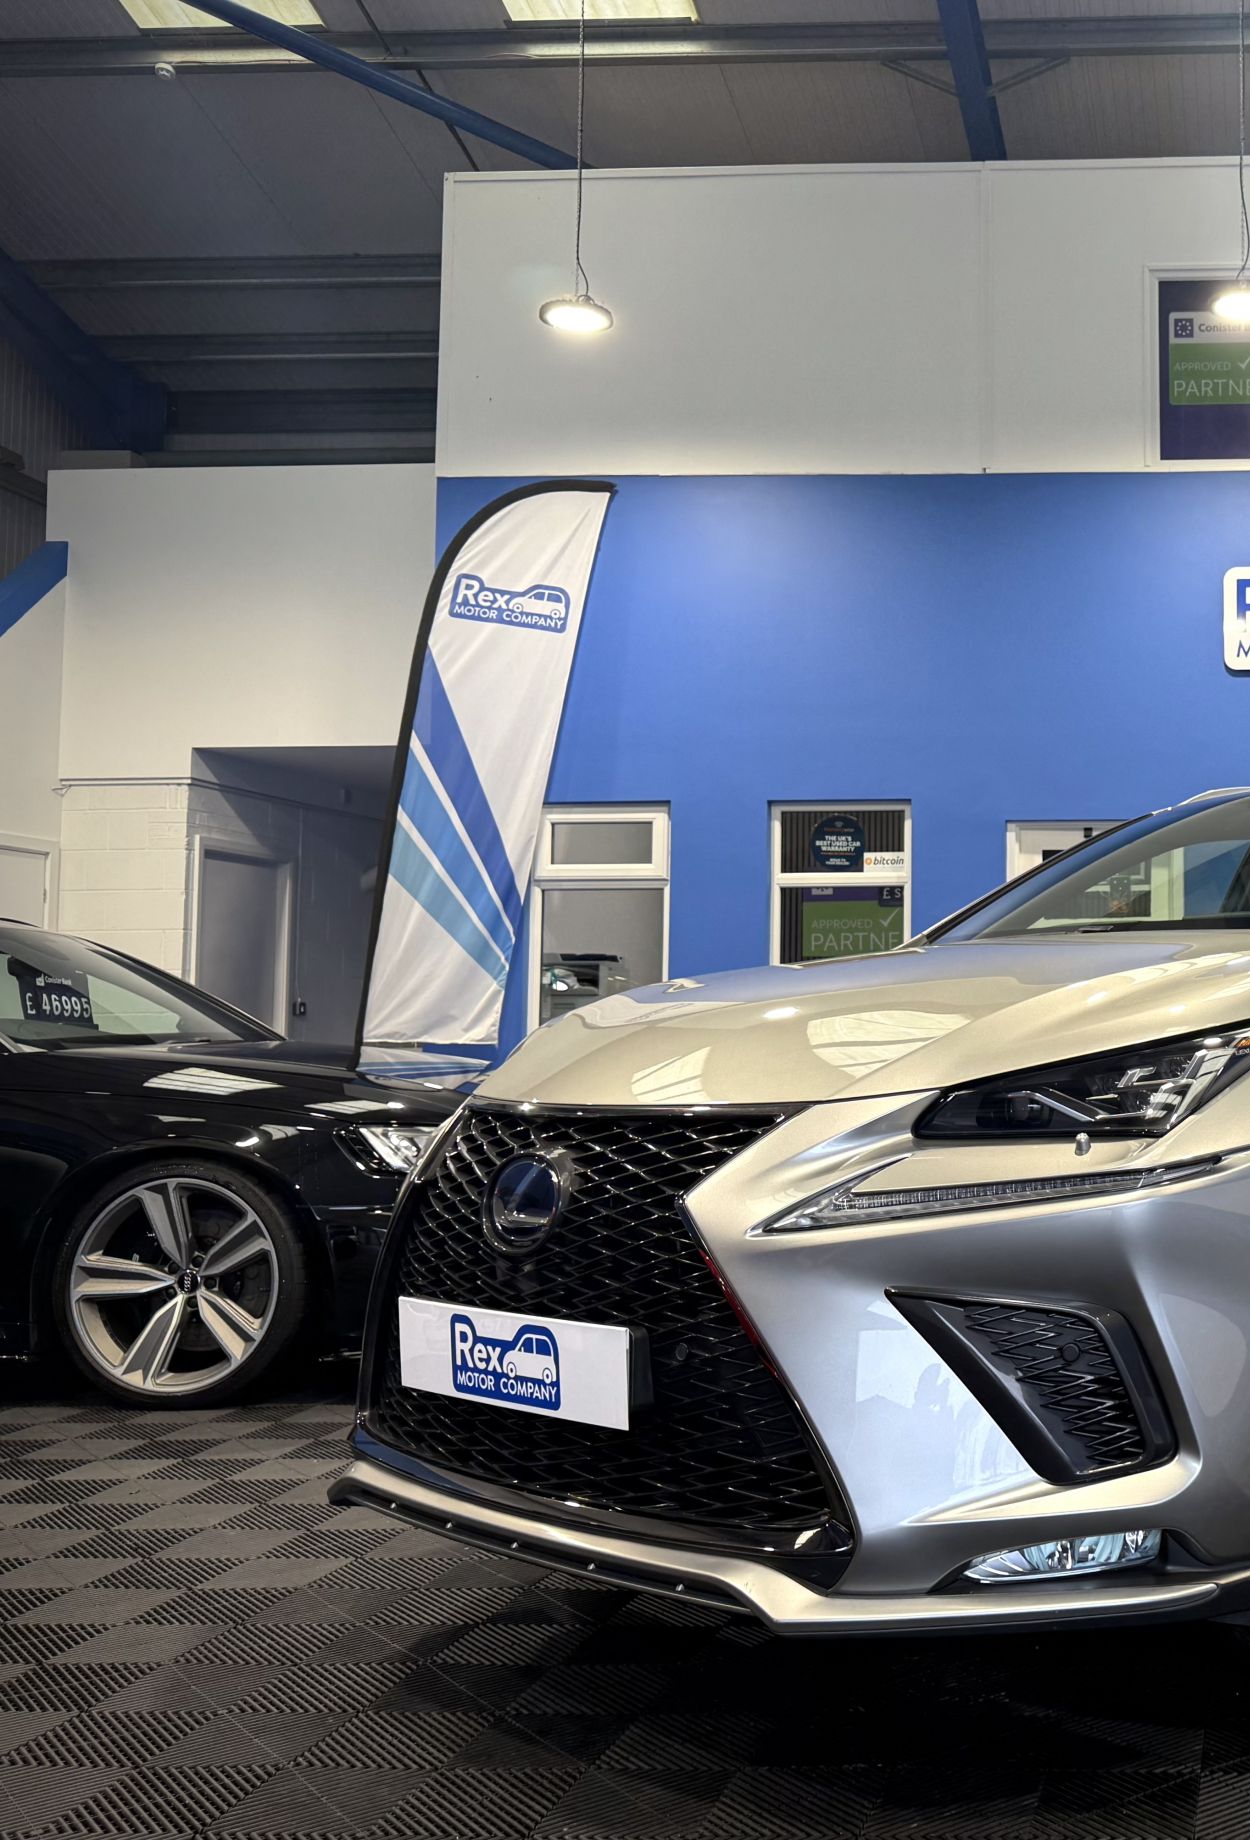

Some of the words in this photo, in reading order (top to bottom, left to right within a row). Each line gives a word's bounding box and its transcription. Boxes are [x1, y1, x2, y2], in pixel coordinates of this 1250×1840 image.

[1174, 361, 1231, 371] APPROVED
[456, 578, 511, 610] Rex
[453, 605, 498, 619] MOTOR
[502, 611, 564, 629] COMPANY
[873, 856, 904, 866] bitcoin
[811, 919, 873, 929] APPROVED
[42, 993, 91, 1018] 46995
[454, 1322, 503, 1373] Rex
[456, 1370, 495, 1392] MOTOR
[499, 1377, 557, 1403] COMPANY
